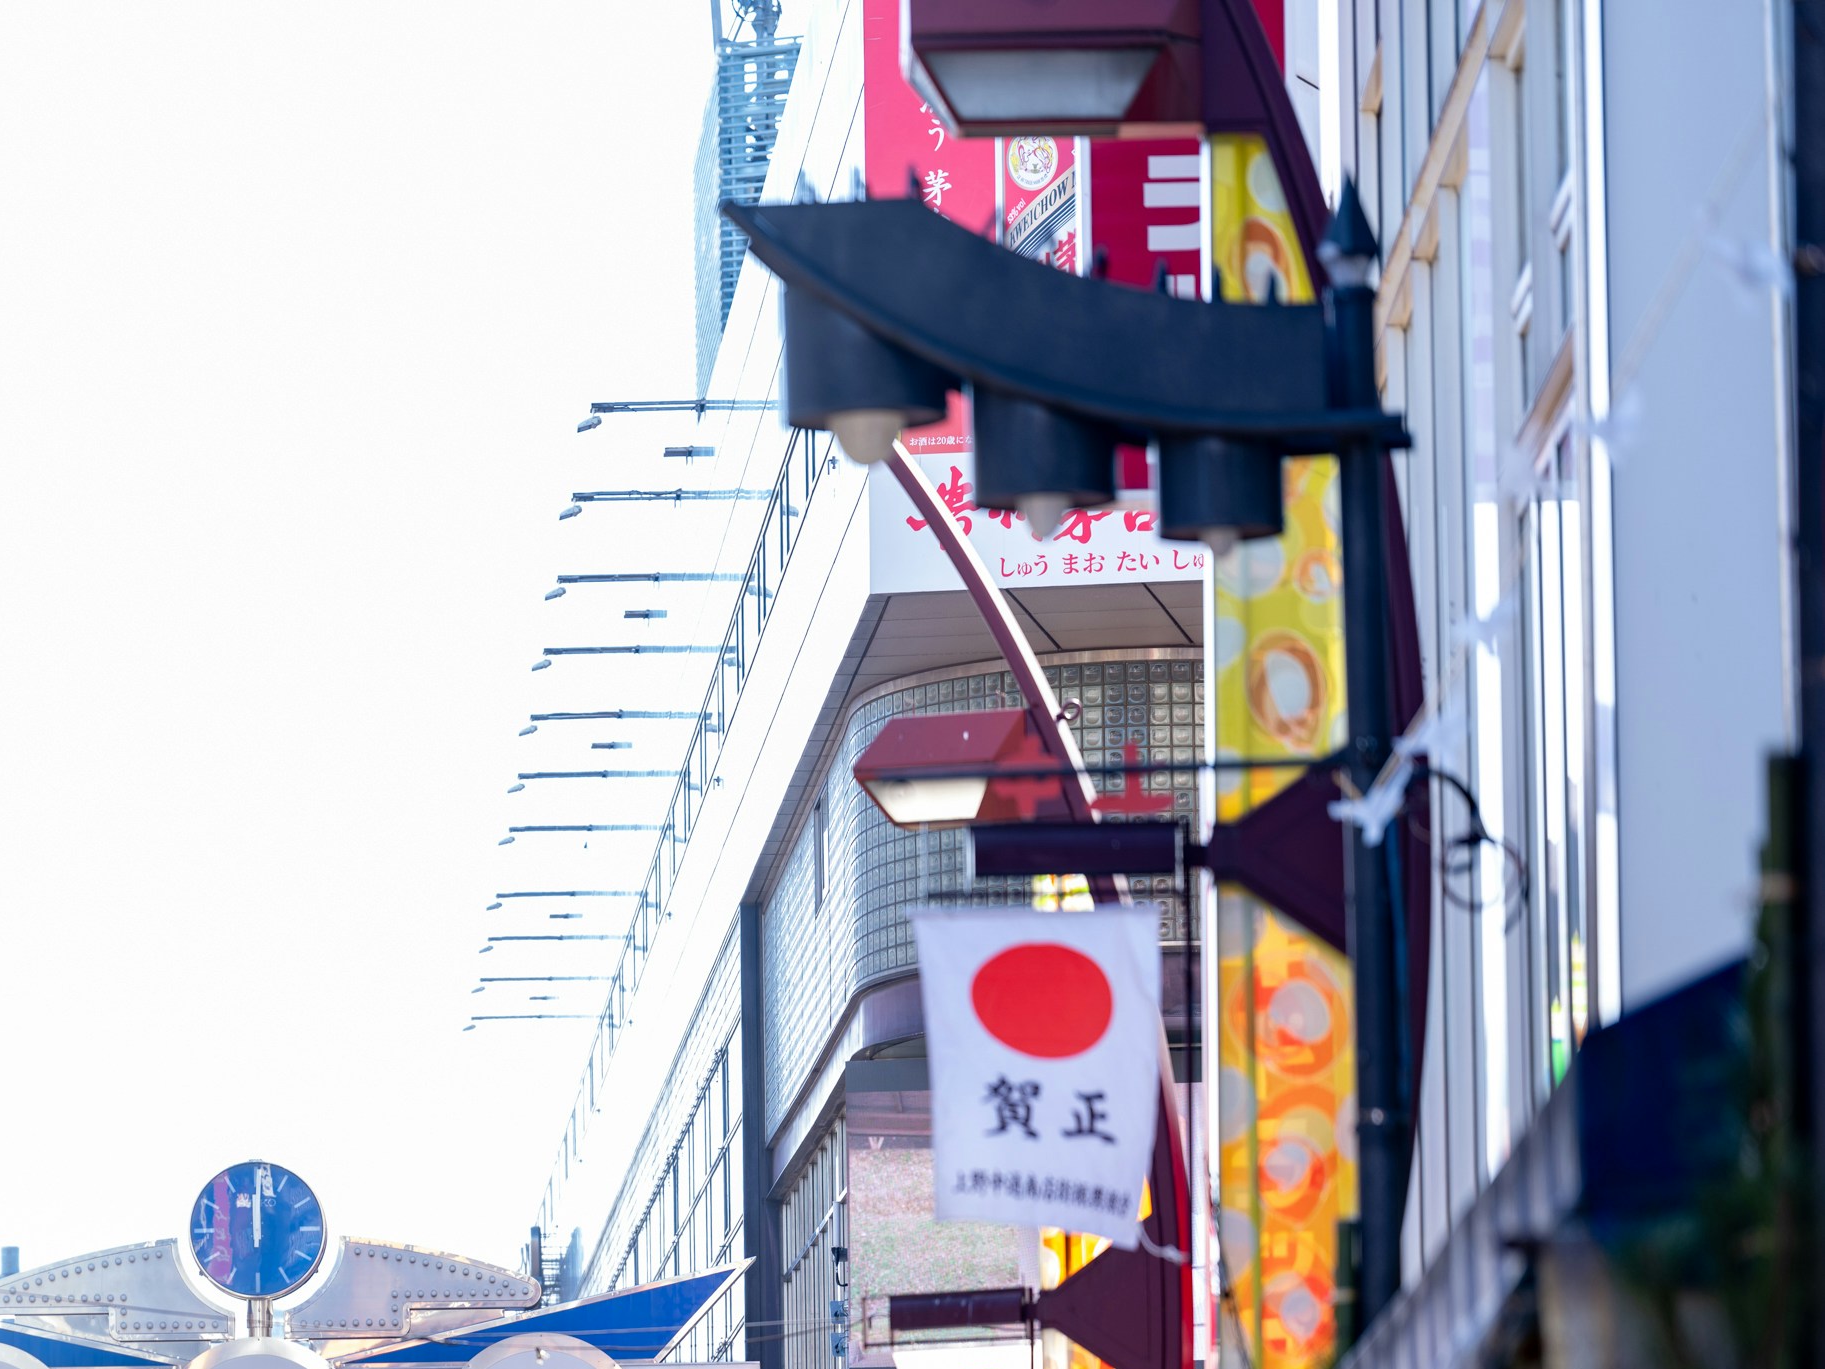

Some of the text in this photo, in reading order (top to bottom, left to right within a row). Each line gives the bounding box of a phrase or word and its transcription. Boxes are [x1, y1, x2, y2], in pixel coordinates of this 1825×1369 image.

[1009, 176, 1070, 248] KWEICHOW
[1000, 554, 1049, 577] しゅう
[1062, 552, 1105, 575] まお
[1117, 551, 1160, 571] たい
[986, 1075, 1117, 1145] 賀正
